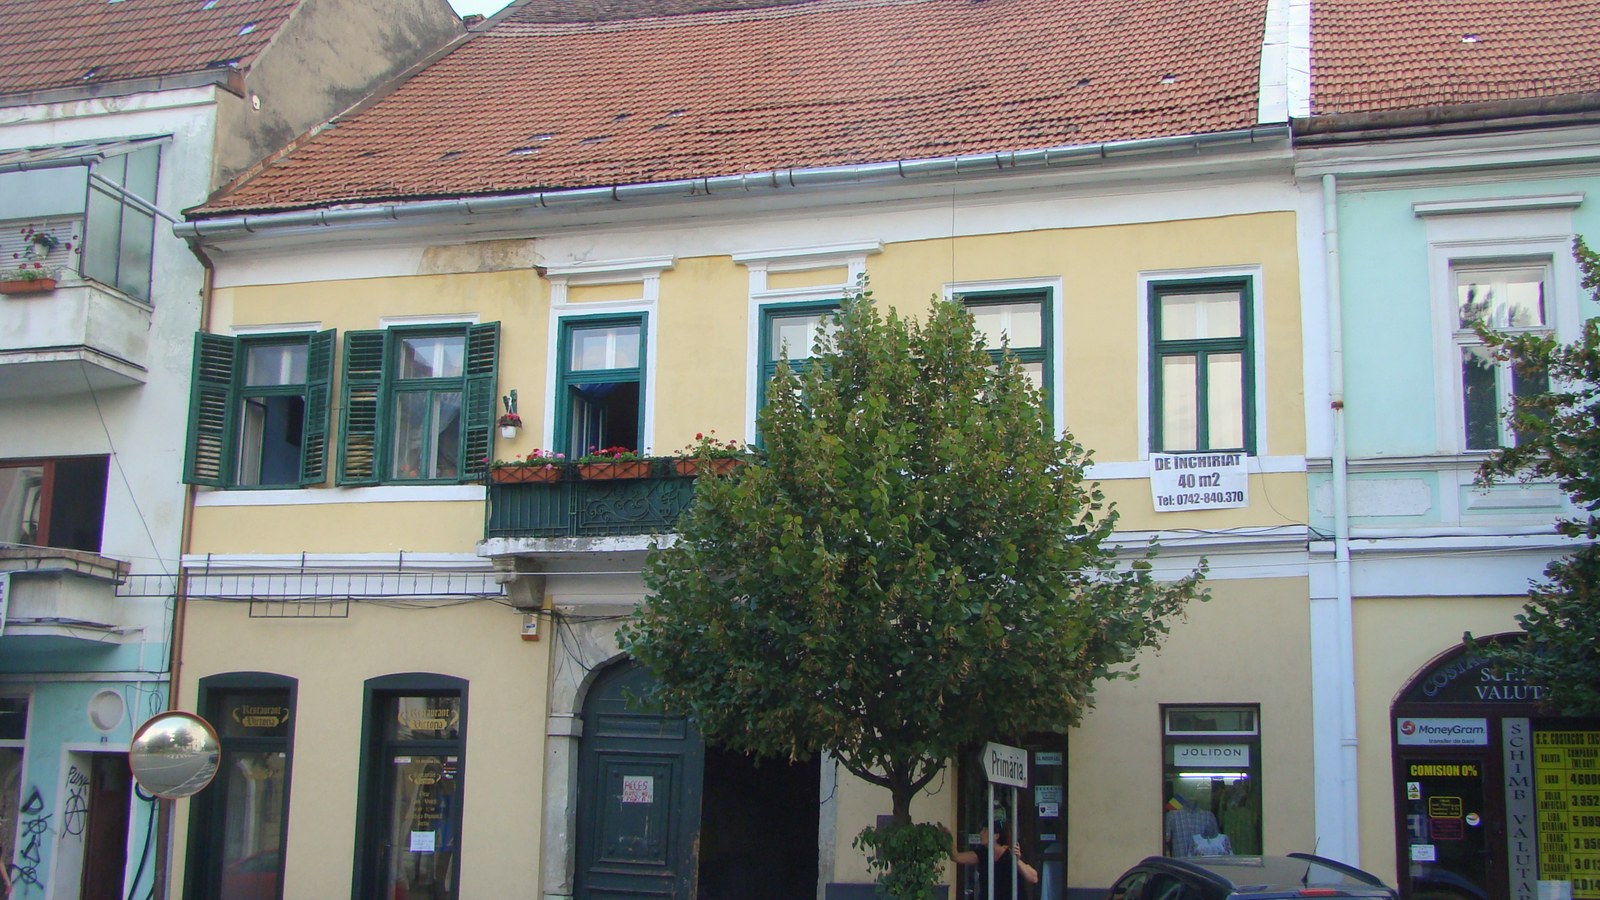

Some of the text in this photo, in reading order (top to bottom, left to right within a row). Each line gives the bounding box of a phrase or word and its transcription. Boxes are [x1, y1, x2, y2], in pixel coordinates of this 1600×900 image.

[1154, 457, 1171, 471] DE
[1178, 472, 1220, 489] 40 m2
[1157, 491, 1244, 506] Tel: 0742-840.370
[1418, 725, 1484, 736] MoneyGram
[1181, 748, 1242, 757] JOLIDON
[1508, 723, 1529, 800] SCHIMB
[1410, 764, 1478, 777] COMISION 0%
